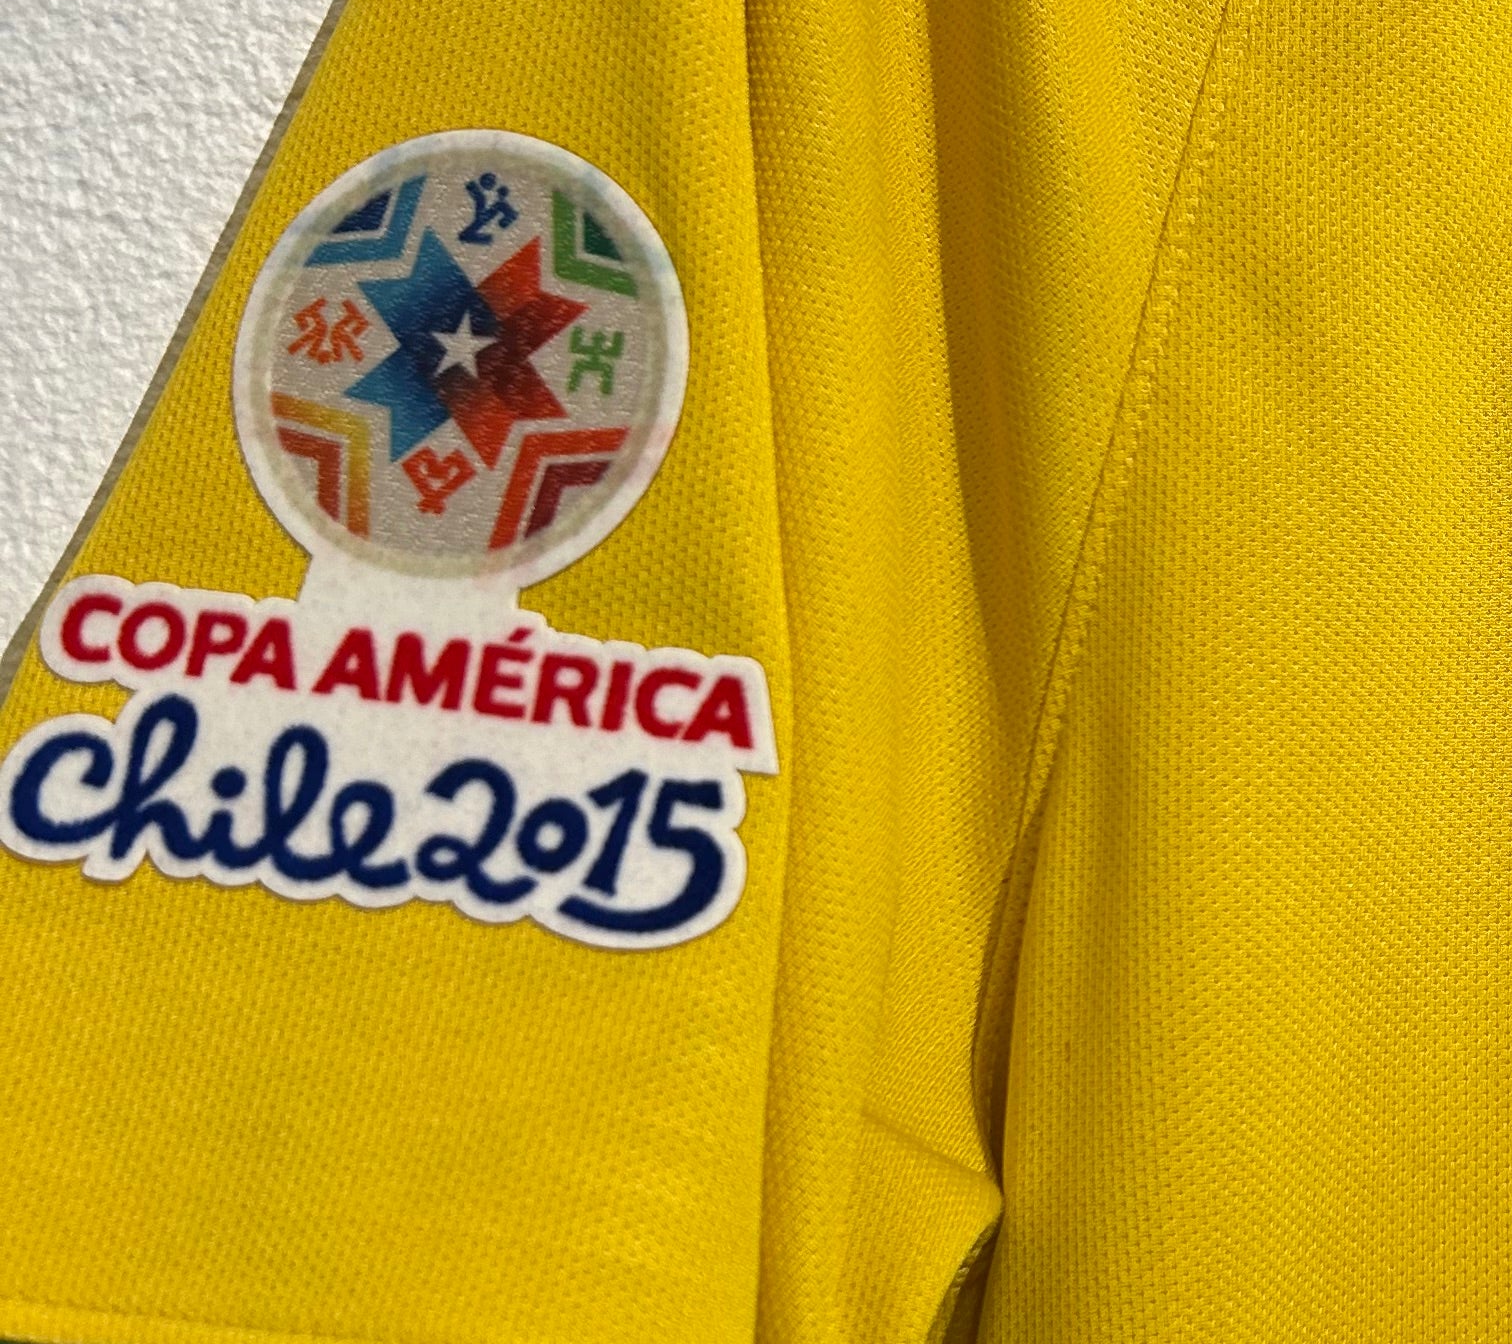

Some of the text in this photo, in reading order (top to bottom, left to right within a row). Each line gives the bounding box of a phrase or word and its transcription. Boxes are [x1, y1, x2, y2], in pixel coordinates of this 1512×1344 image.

[60, 594, 756, 751] COPA AMÉRICA
[413, 759, 725, 934] 2015
